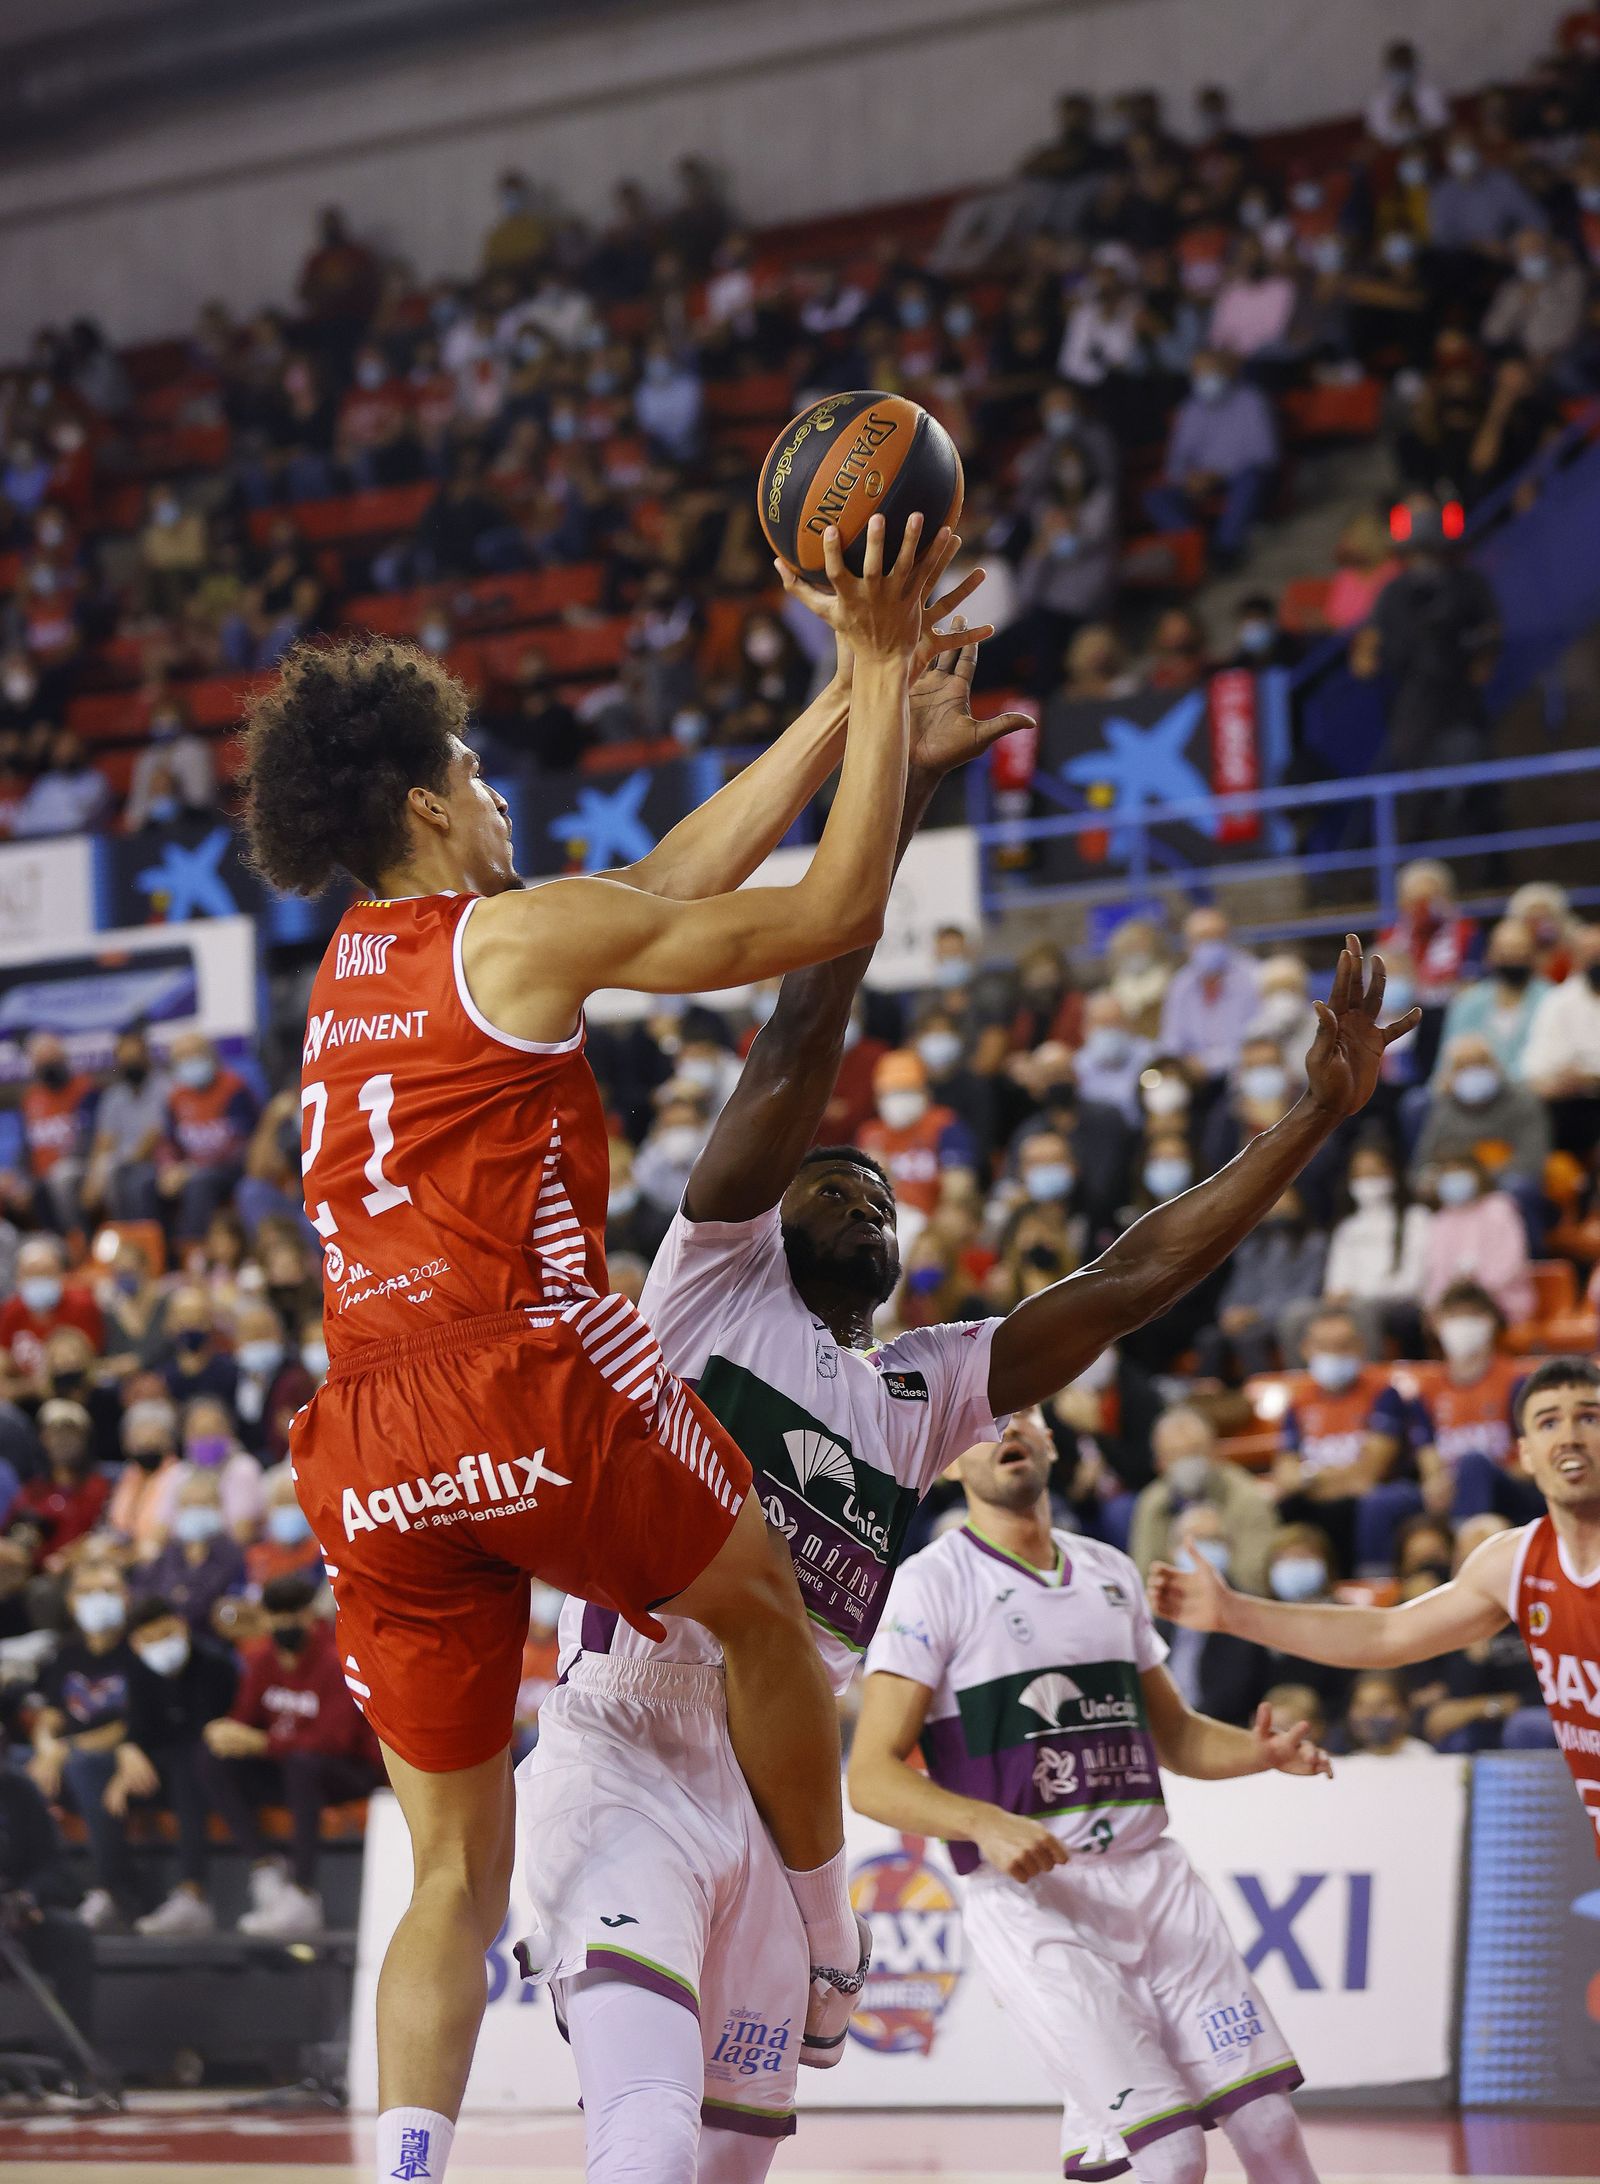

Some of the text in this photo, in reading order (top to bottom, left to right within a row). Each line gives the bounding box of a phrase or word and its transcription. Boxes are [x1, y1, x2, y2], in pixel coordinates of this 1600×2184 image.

[768, 423, 811, 523] endesa
[804, 412, 898, 536] SPALDING
[409, 1257, 451, 1282] 2022
[891, 1388, 928, 1398] endesa
[413, 1516, 429, 1530] el
[431, 1508, 469, 1526] agua
[1530, 1644, 1600, 1718] BAX
[1234, 1873, 1371, 1990] XI
[710, 2032, 782, 2075] laga
[732, 2018, 791, 2051] má
[1206, 2018, 1265, 2053] laga
